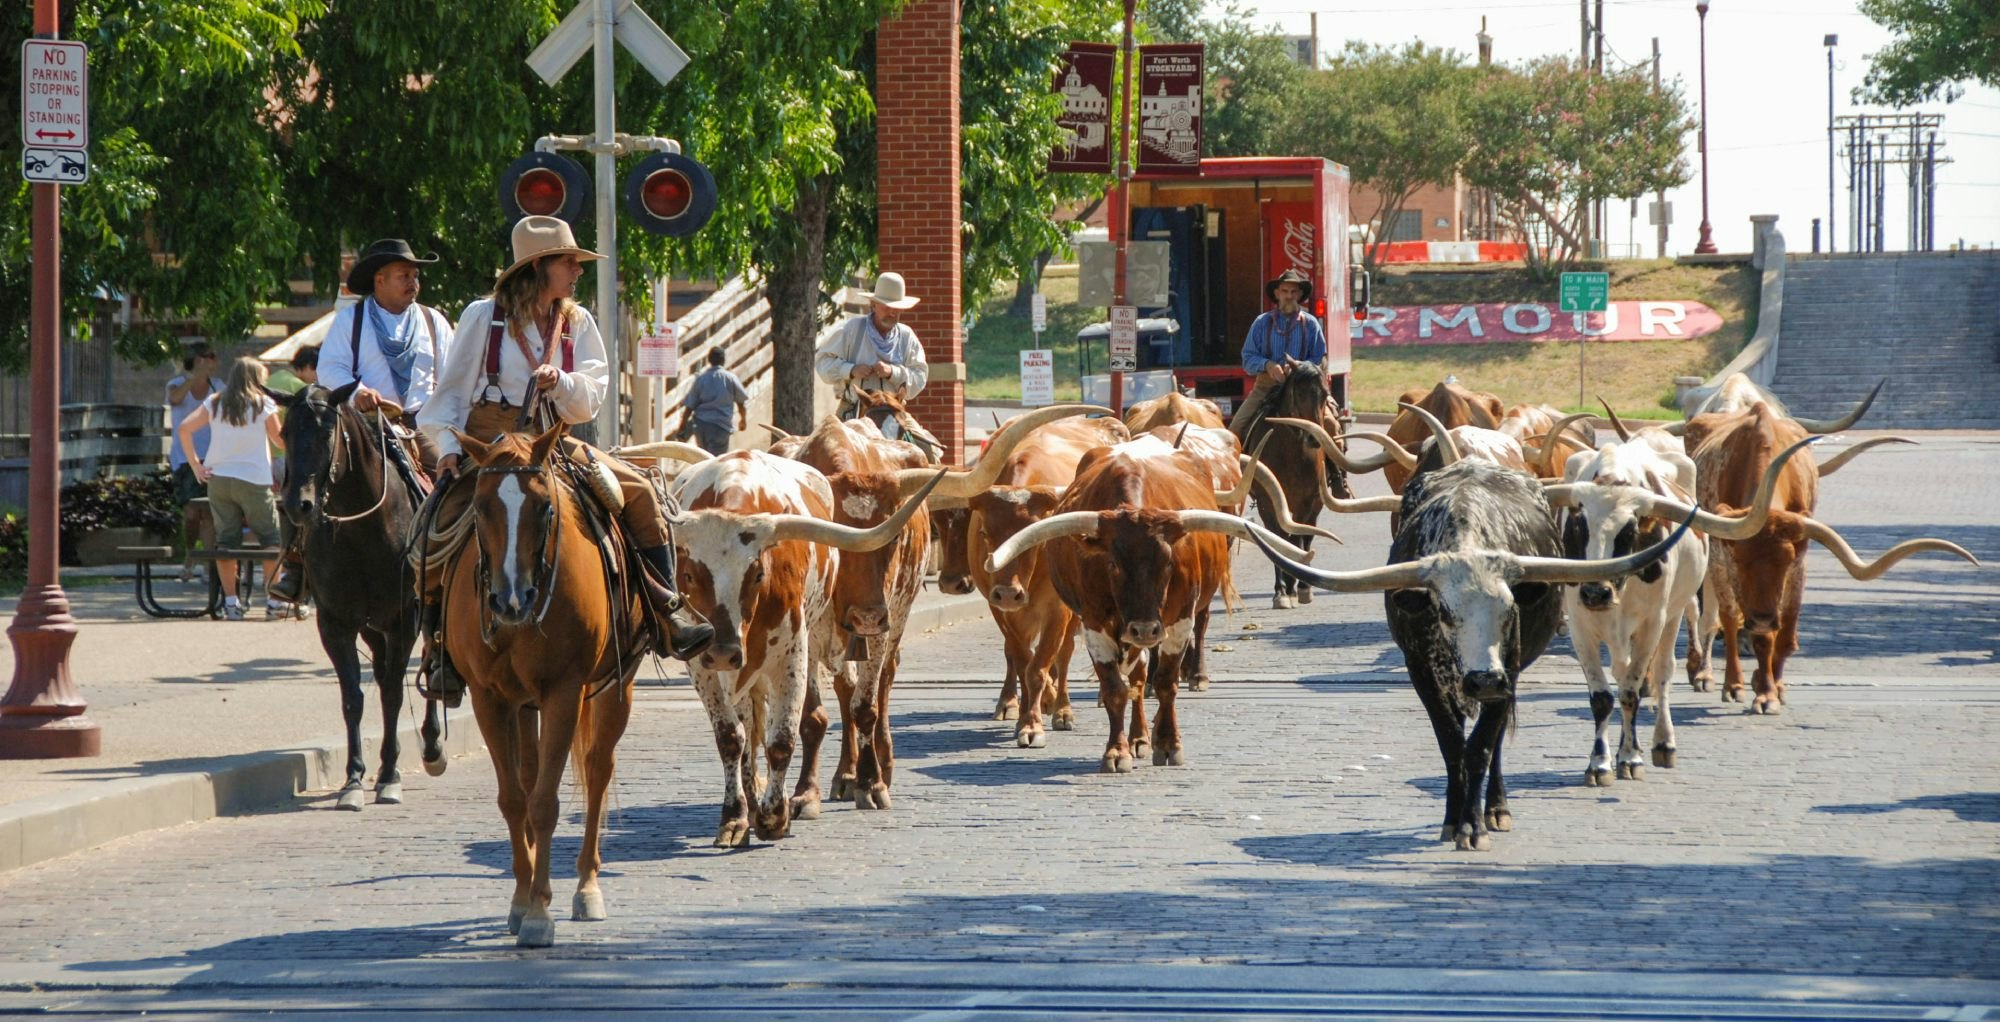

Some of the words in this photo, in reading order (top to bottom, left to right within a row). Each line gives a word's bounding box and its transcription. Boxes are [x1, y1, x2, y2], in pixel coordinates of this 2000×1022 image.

[44, 49, 66, 65] NO
[32, 68, 77, 82] PARKING
[29, 82, 80, 97] STOPPING
[47, 98, 62, 110] OR
[29, 111, 81, 125] STANDING
[1564, 275, 1573, 283] TO
[1586, 275, 1605, 283] MAIN
[1119, 310, 1130, 318] NO
